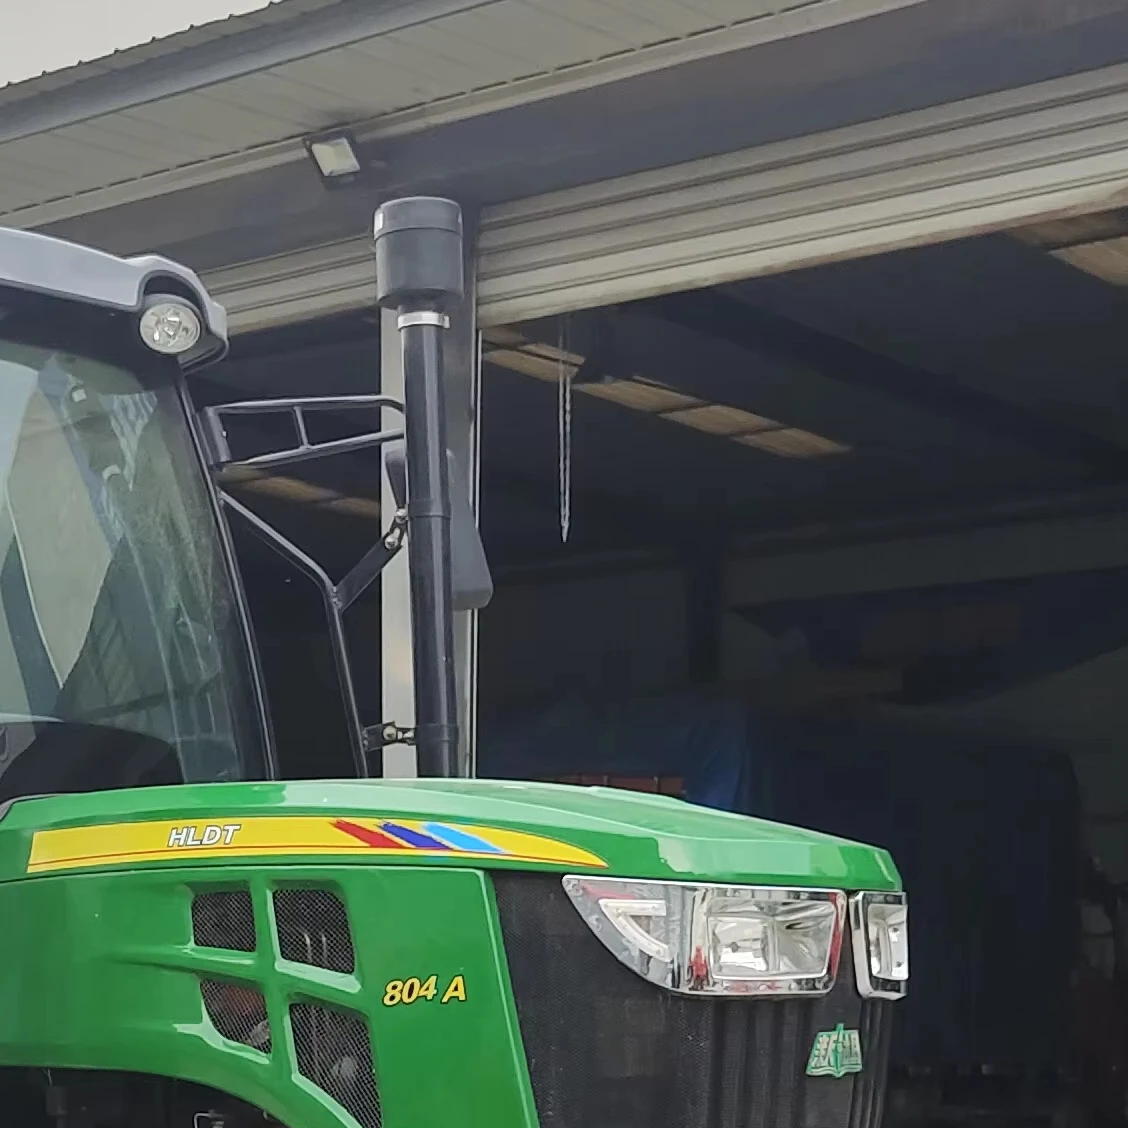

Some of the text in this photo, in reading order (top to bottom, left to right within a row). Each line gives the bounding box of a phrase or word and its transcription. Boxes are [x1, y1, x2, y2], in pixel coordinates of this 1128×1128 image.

[167, 824, 242, 847] HLDT
[382, 974, 467, 1007] 804 A
